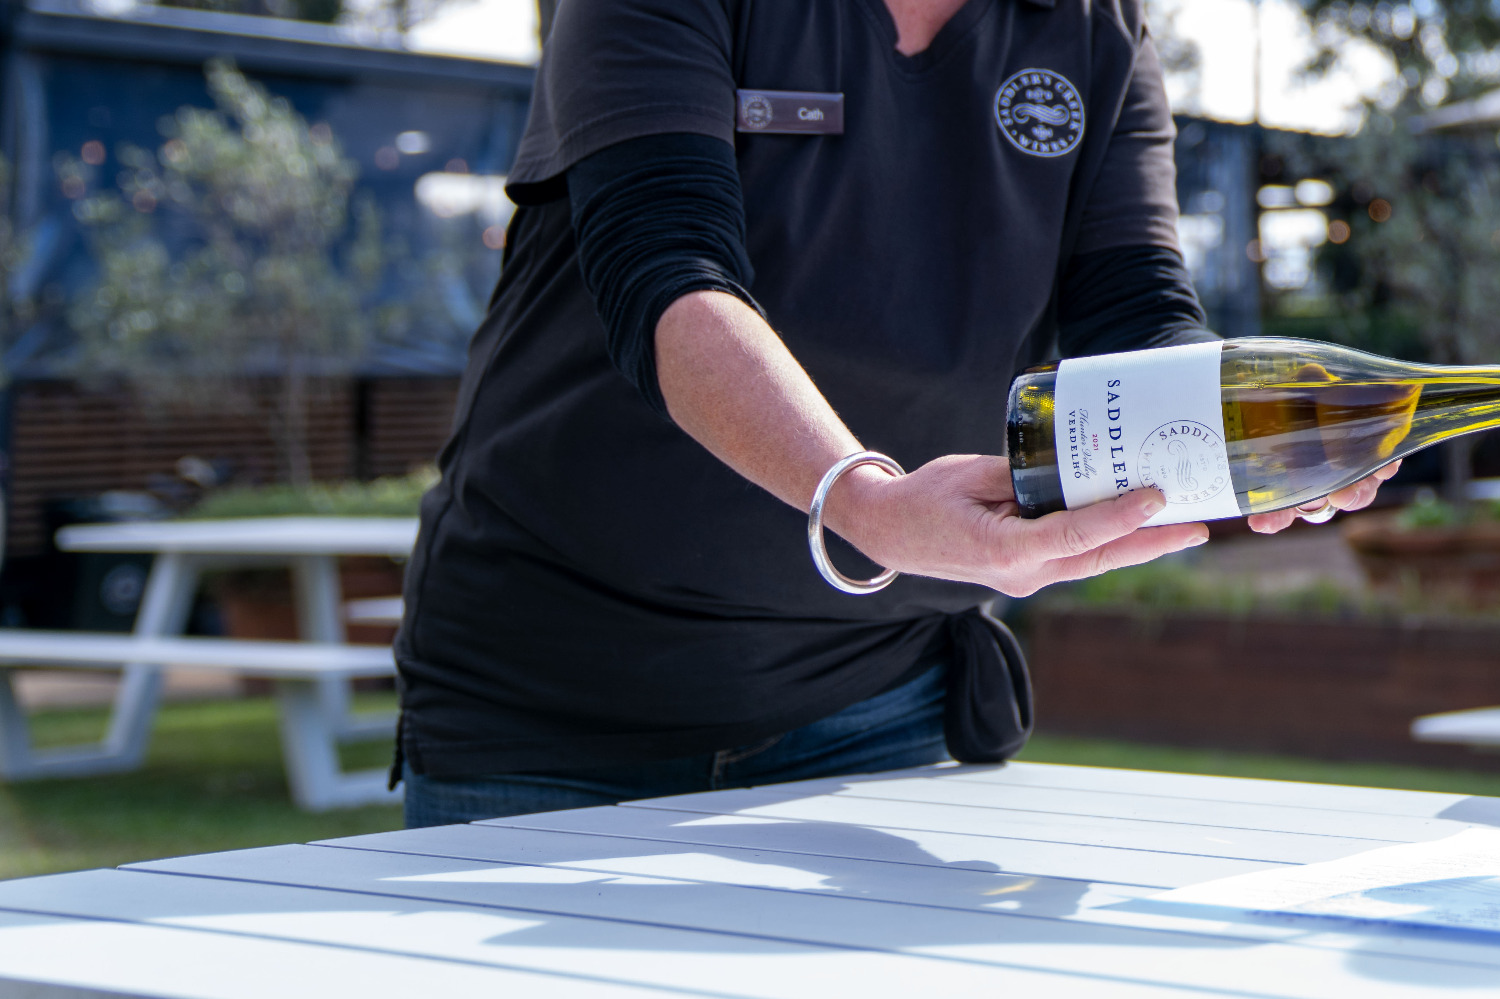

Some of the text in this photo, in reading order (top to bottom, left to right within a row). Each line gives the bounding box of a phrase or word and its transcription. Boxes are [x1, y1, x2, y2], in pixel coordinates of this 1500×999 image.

[798, 107, 824, 121] Cath
[999, 73, 1081, 132] SADDLER'S CREEK
[1018, 134, 1068, 152] WINES
[1068, 410, 1082, 479] VERDELHO
[1079, 408, 1089, 446] Hunter
